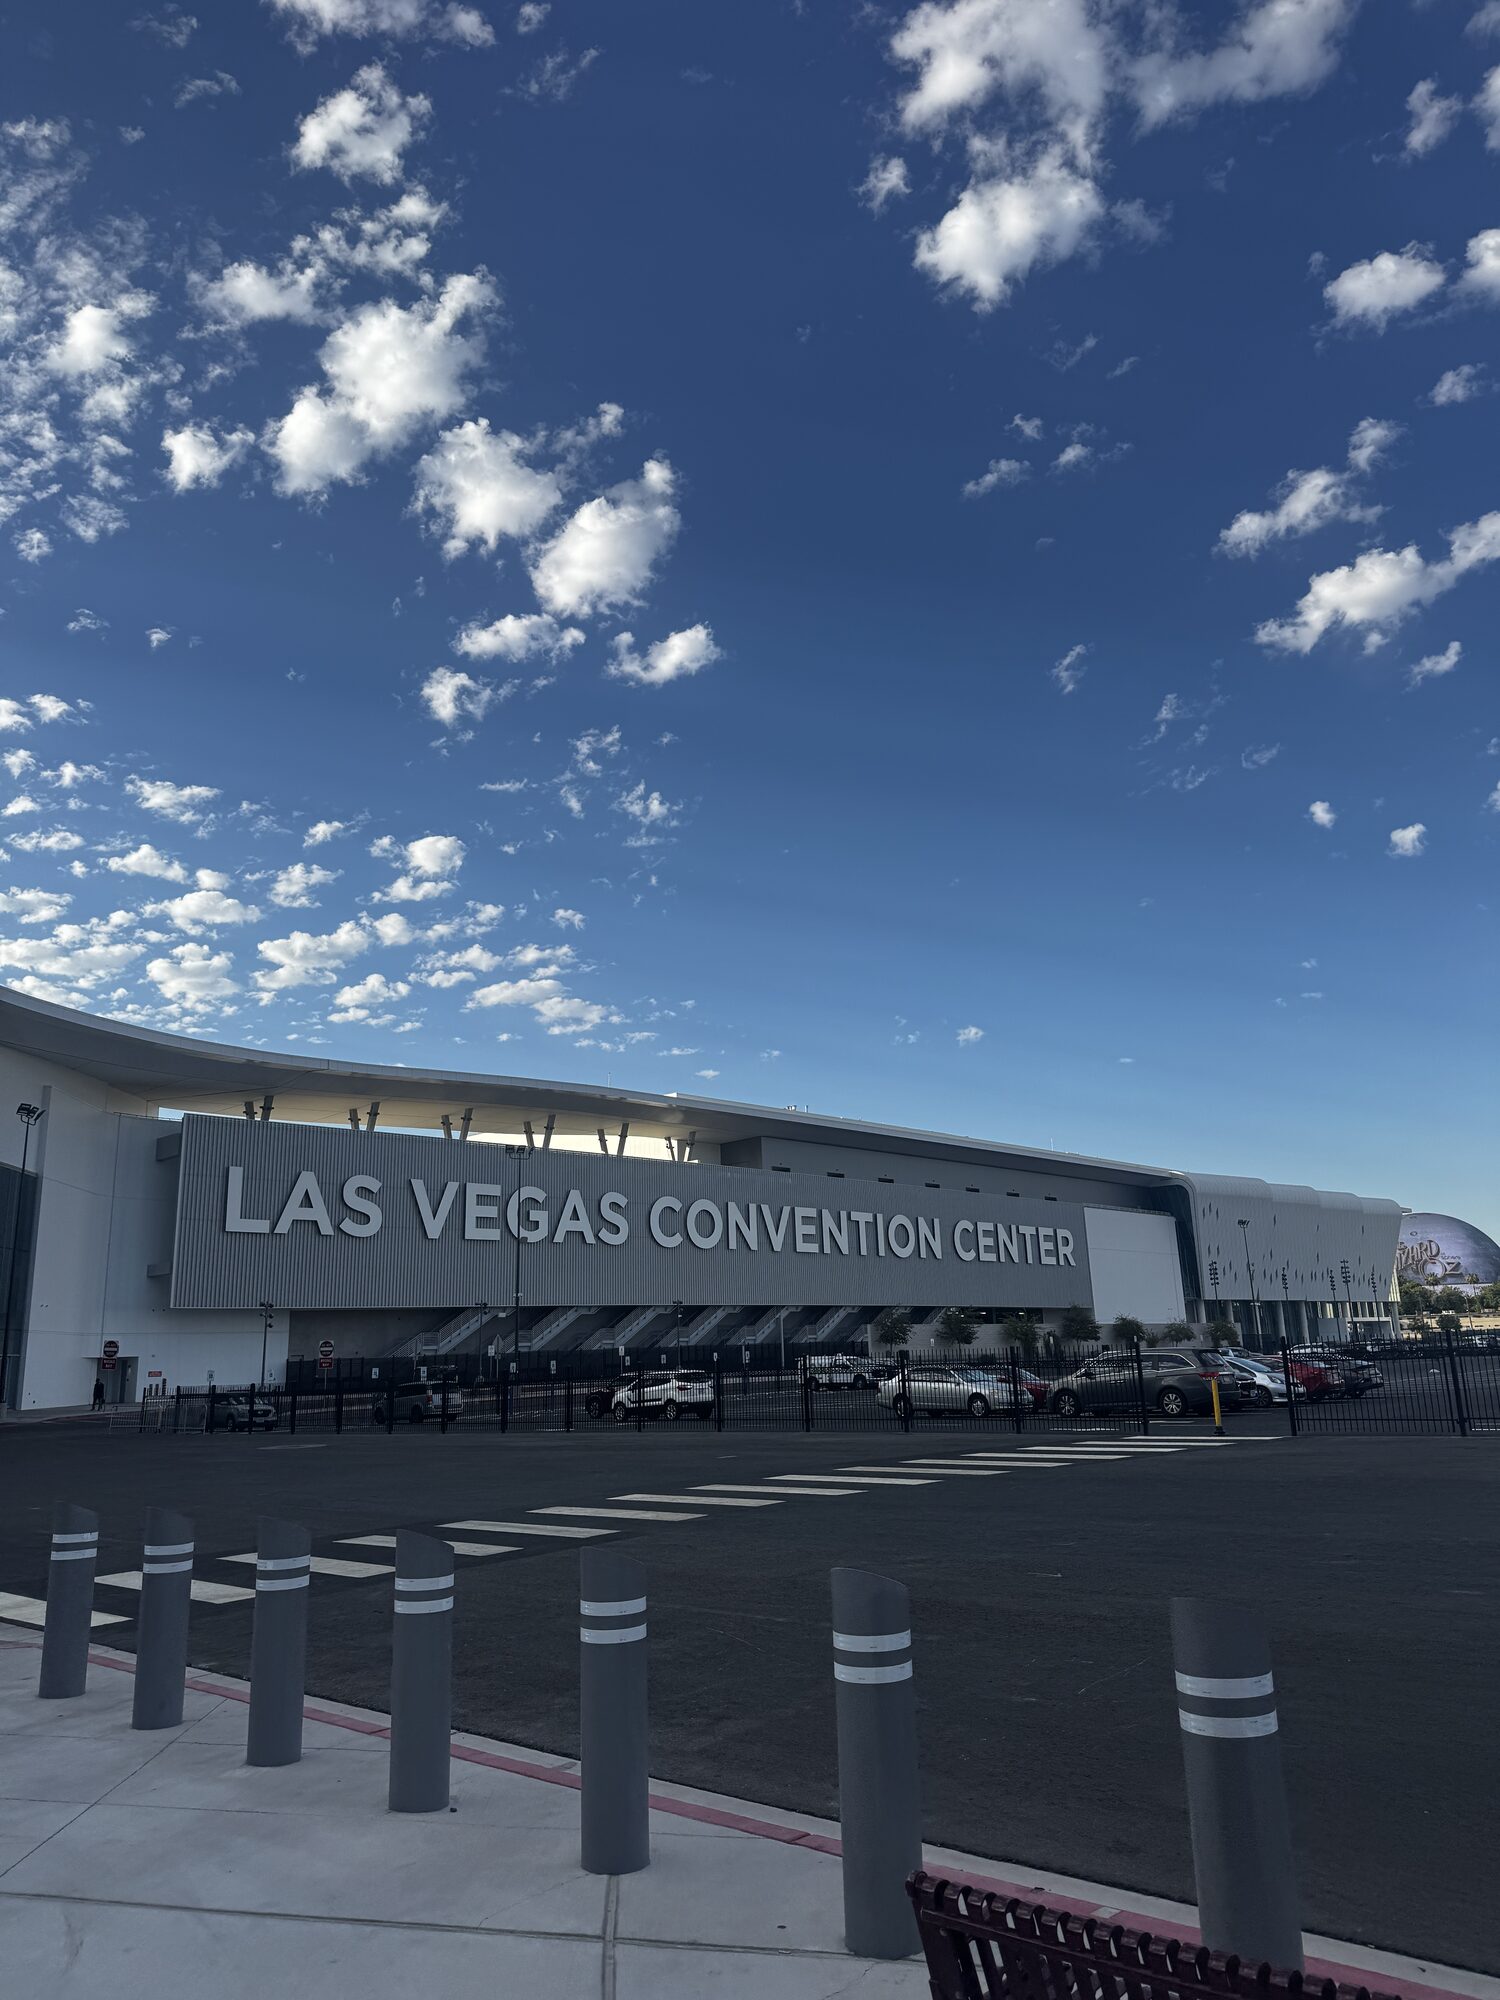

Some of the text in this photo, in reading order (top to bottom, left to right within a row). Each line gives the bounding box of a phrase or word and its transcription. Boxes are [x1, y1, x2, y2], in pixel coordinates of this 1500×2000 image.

[225, 1165, 1077, 1266] LAS VEGAS CONVENTION CENTER
